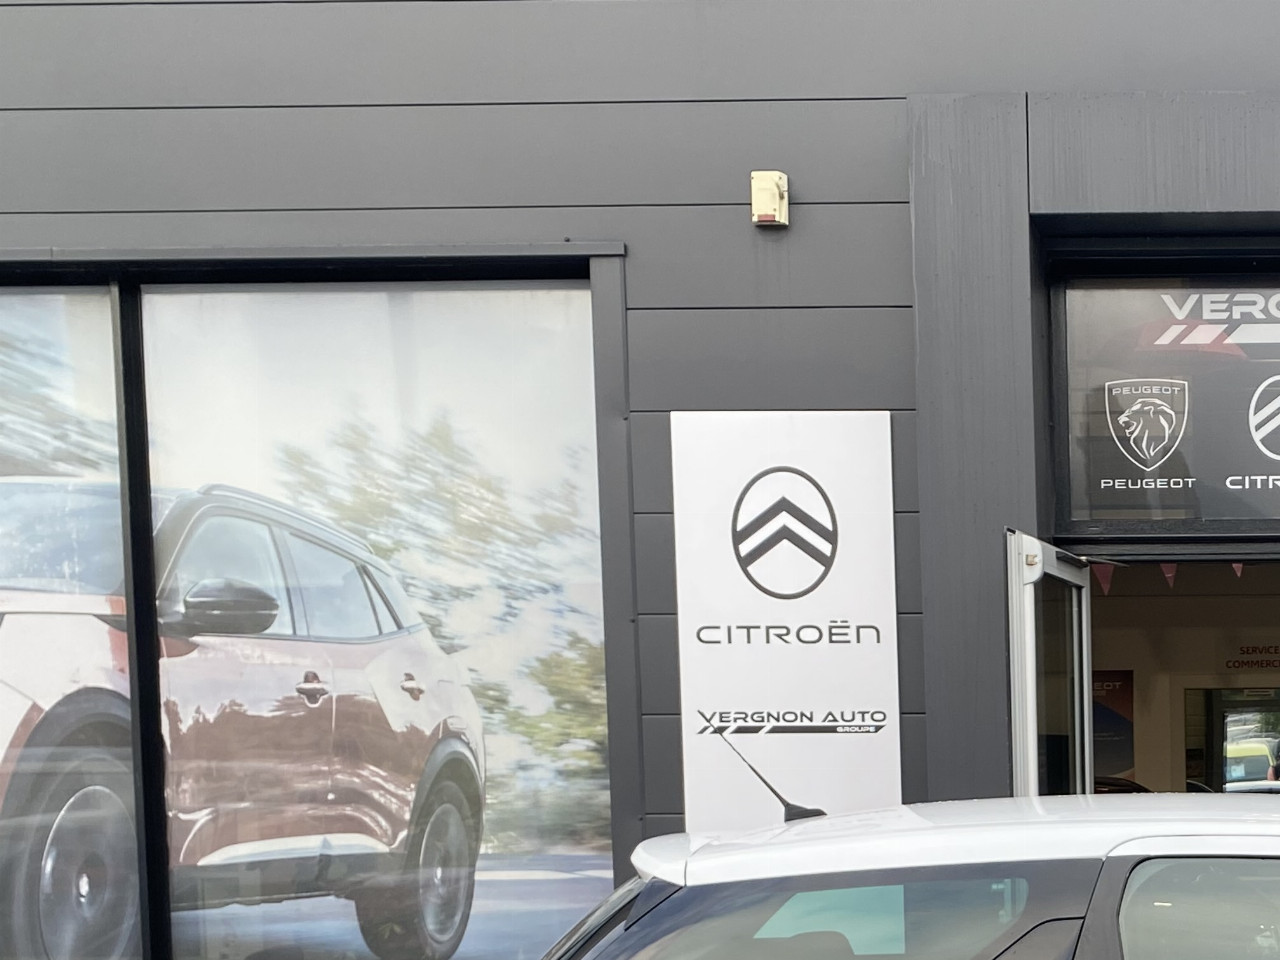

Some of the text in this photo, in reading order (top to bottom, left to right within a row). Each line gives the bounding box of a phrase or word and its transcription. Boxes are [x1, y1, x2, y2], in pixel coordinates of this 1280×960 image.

[1113, 386, 1180, 394] PEUGEOT
[1101, 479, 1196, 488] PEUGEOT
[1239, 646, 1280, 655] SERVICE
[697, 710, 886, 723] VERGNON AUTO
